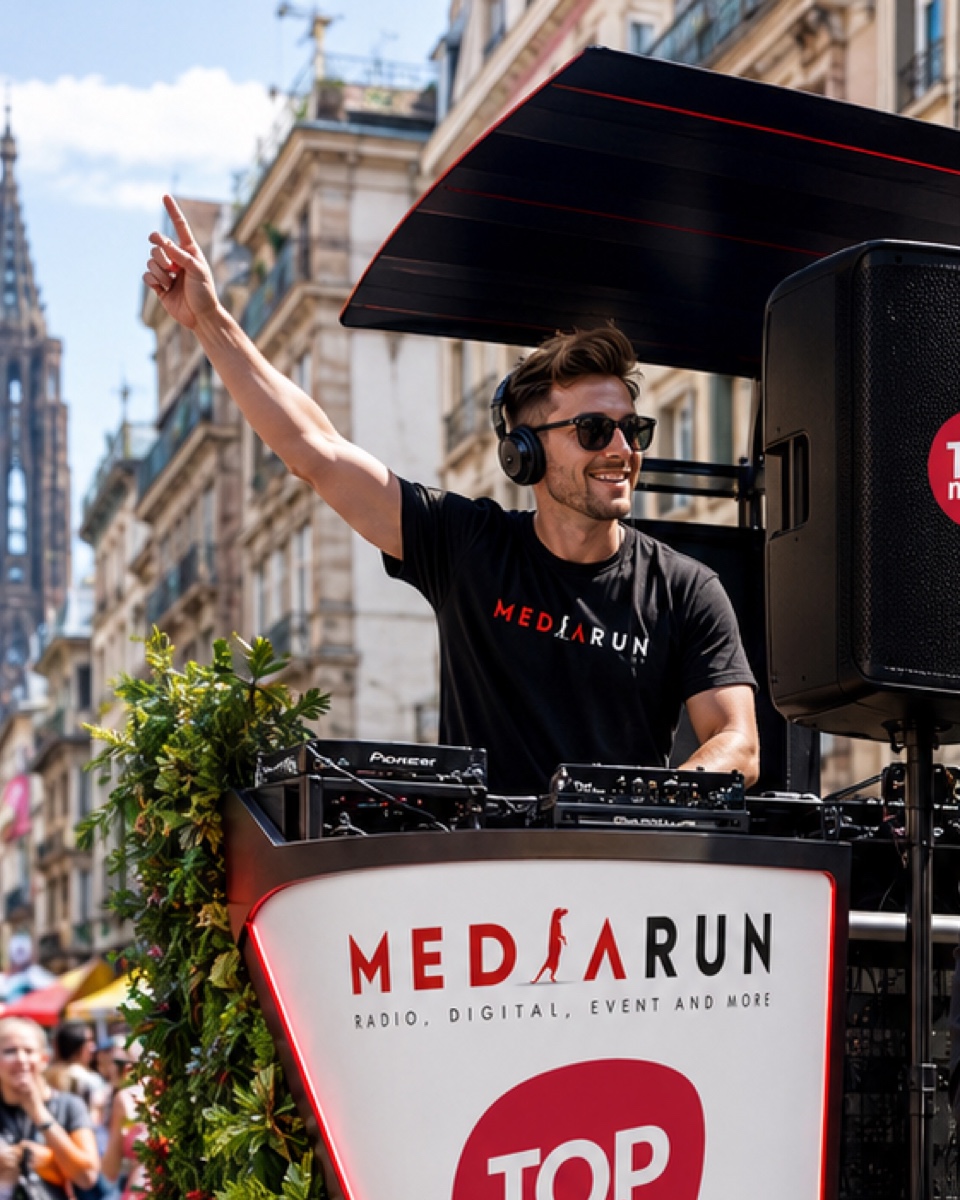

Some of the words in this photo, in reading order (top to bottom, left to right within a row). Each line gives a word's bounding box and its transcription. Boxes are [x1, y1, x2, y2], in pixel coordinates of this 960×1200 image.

[354, 1009, 429, 1029] RADIO,
[449, 1002, 570, 1023] DIGITAL,
[591, 997, 659, 1014] EVENT
[674, 995, 714, 1011] AND
[726, 992, 771, 1009] MORE
